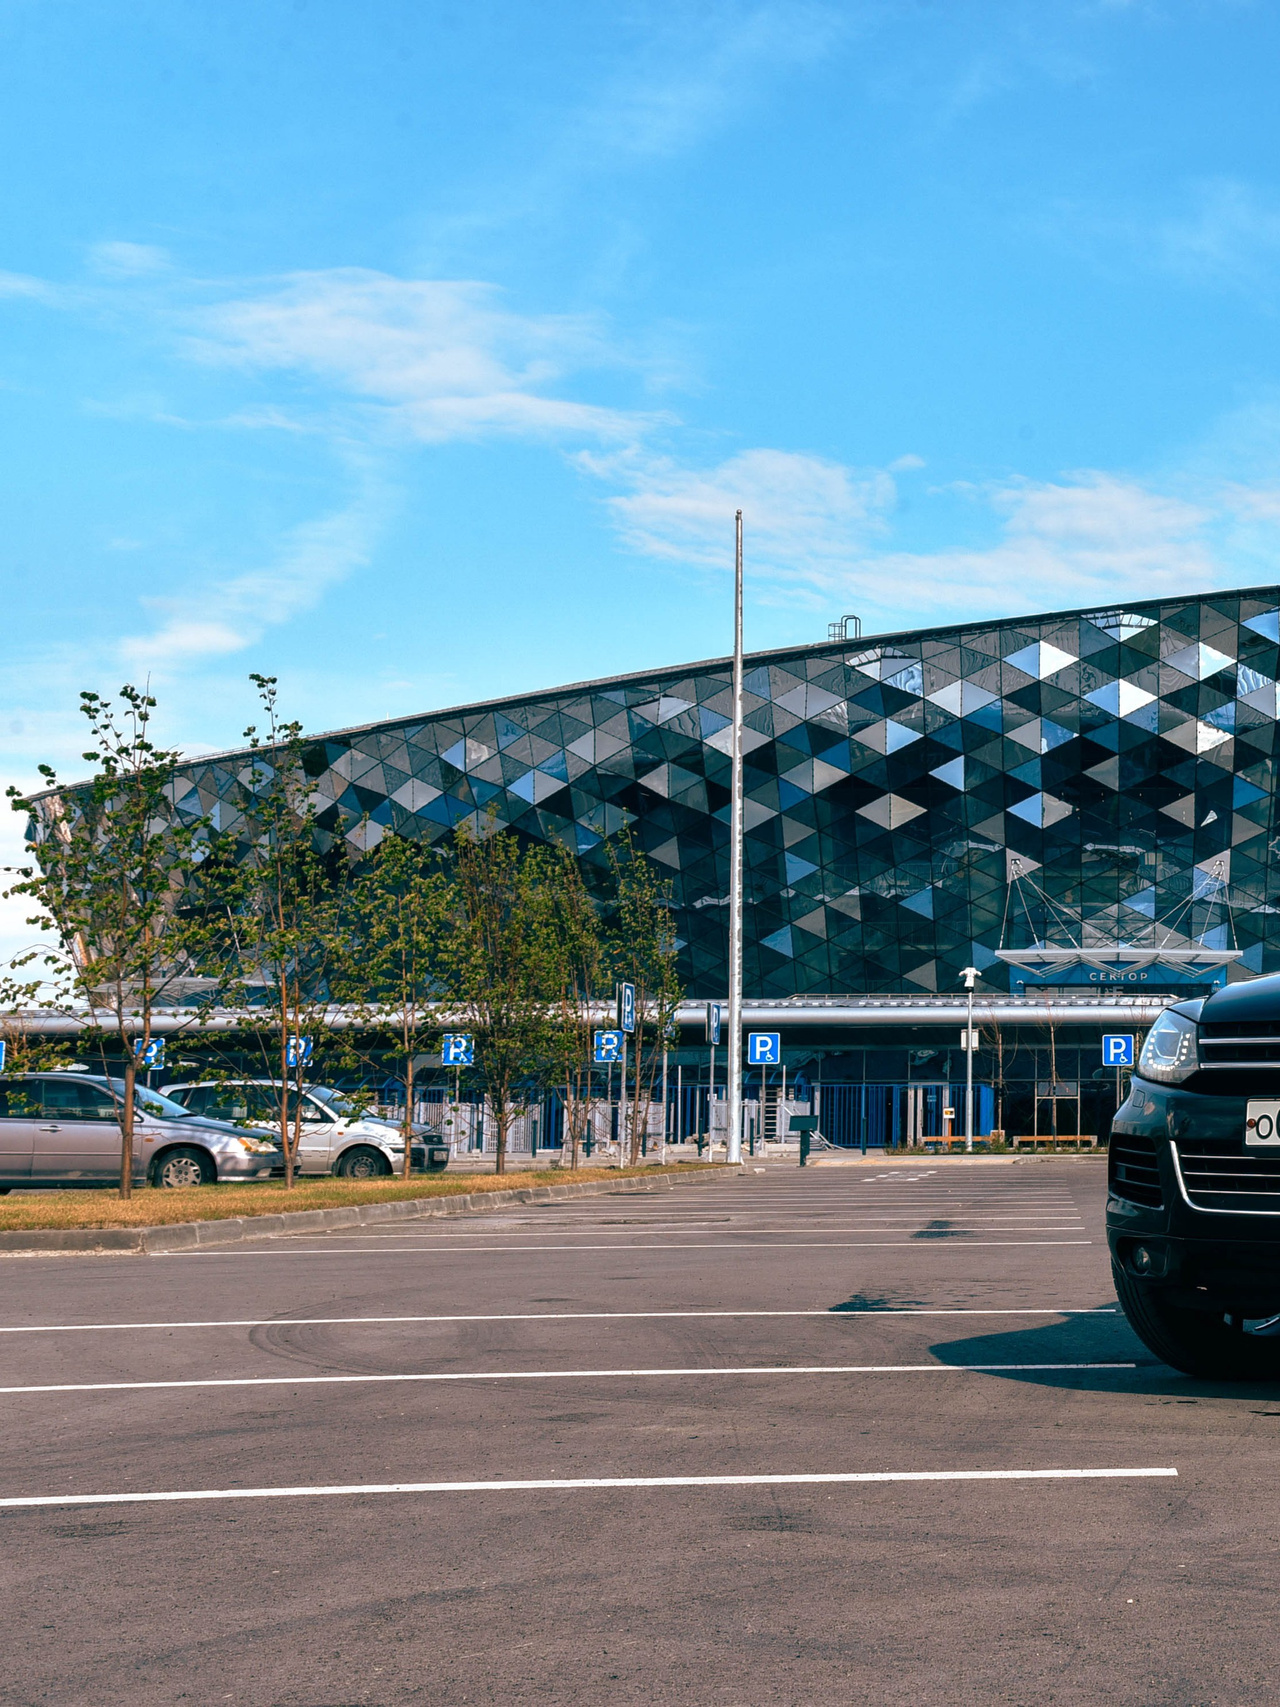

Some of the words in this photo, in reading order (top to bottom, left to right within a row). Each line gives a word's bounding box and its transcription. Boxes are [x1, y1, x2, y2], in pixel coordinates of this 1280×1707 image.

[625, 988, 632, 1024] P
[450, 1036, 467, 1061] P
[601, 1033, 618, 1058] P
[755, 1036, 773, 1060] P
[1110, 1038, 1126, 1062] P
